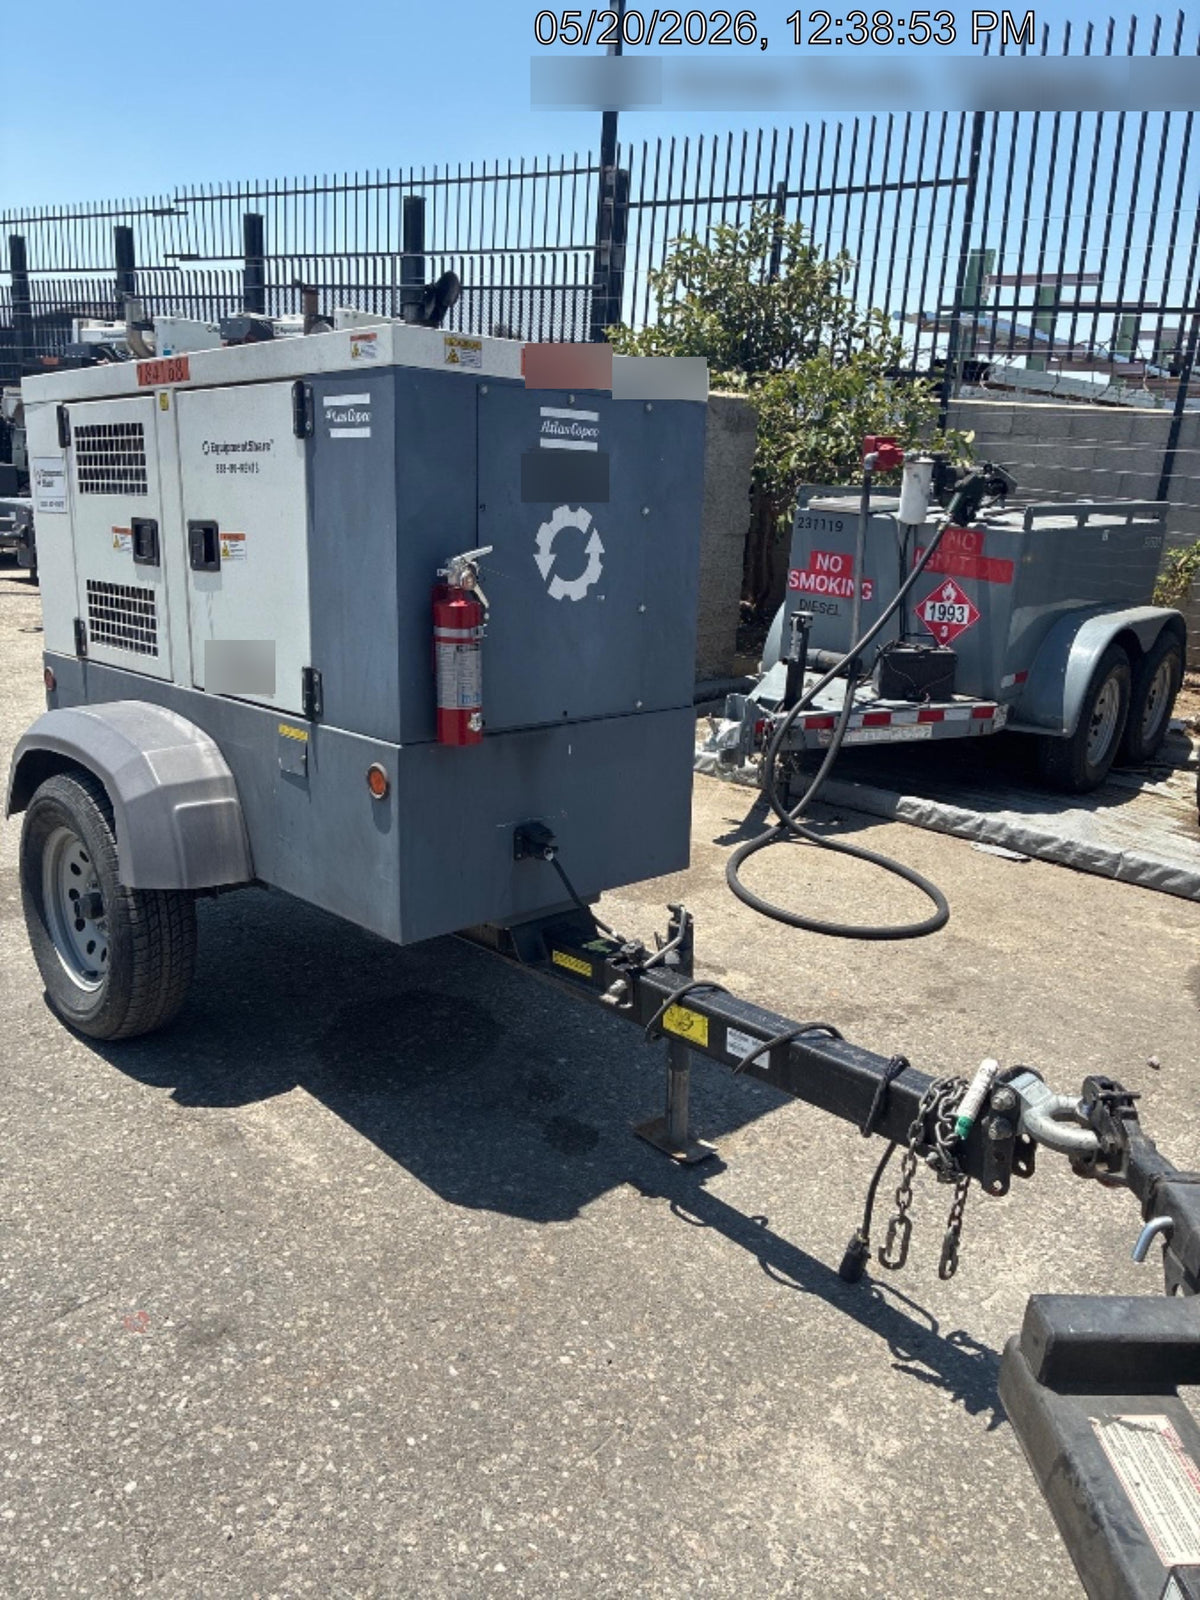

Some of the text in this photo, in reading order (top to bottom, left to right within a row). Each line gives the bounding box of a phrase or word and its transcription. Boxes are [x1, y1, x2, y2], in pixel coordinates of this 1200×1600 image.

[815, 552, 843, 573] NO
[788, 570, 874, 600] SMOKING
[799, 598, 841, 617] DIESEL
[929, 603, 965, 623] 1993
[940, 625, 949, 638] 3
